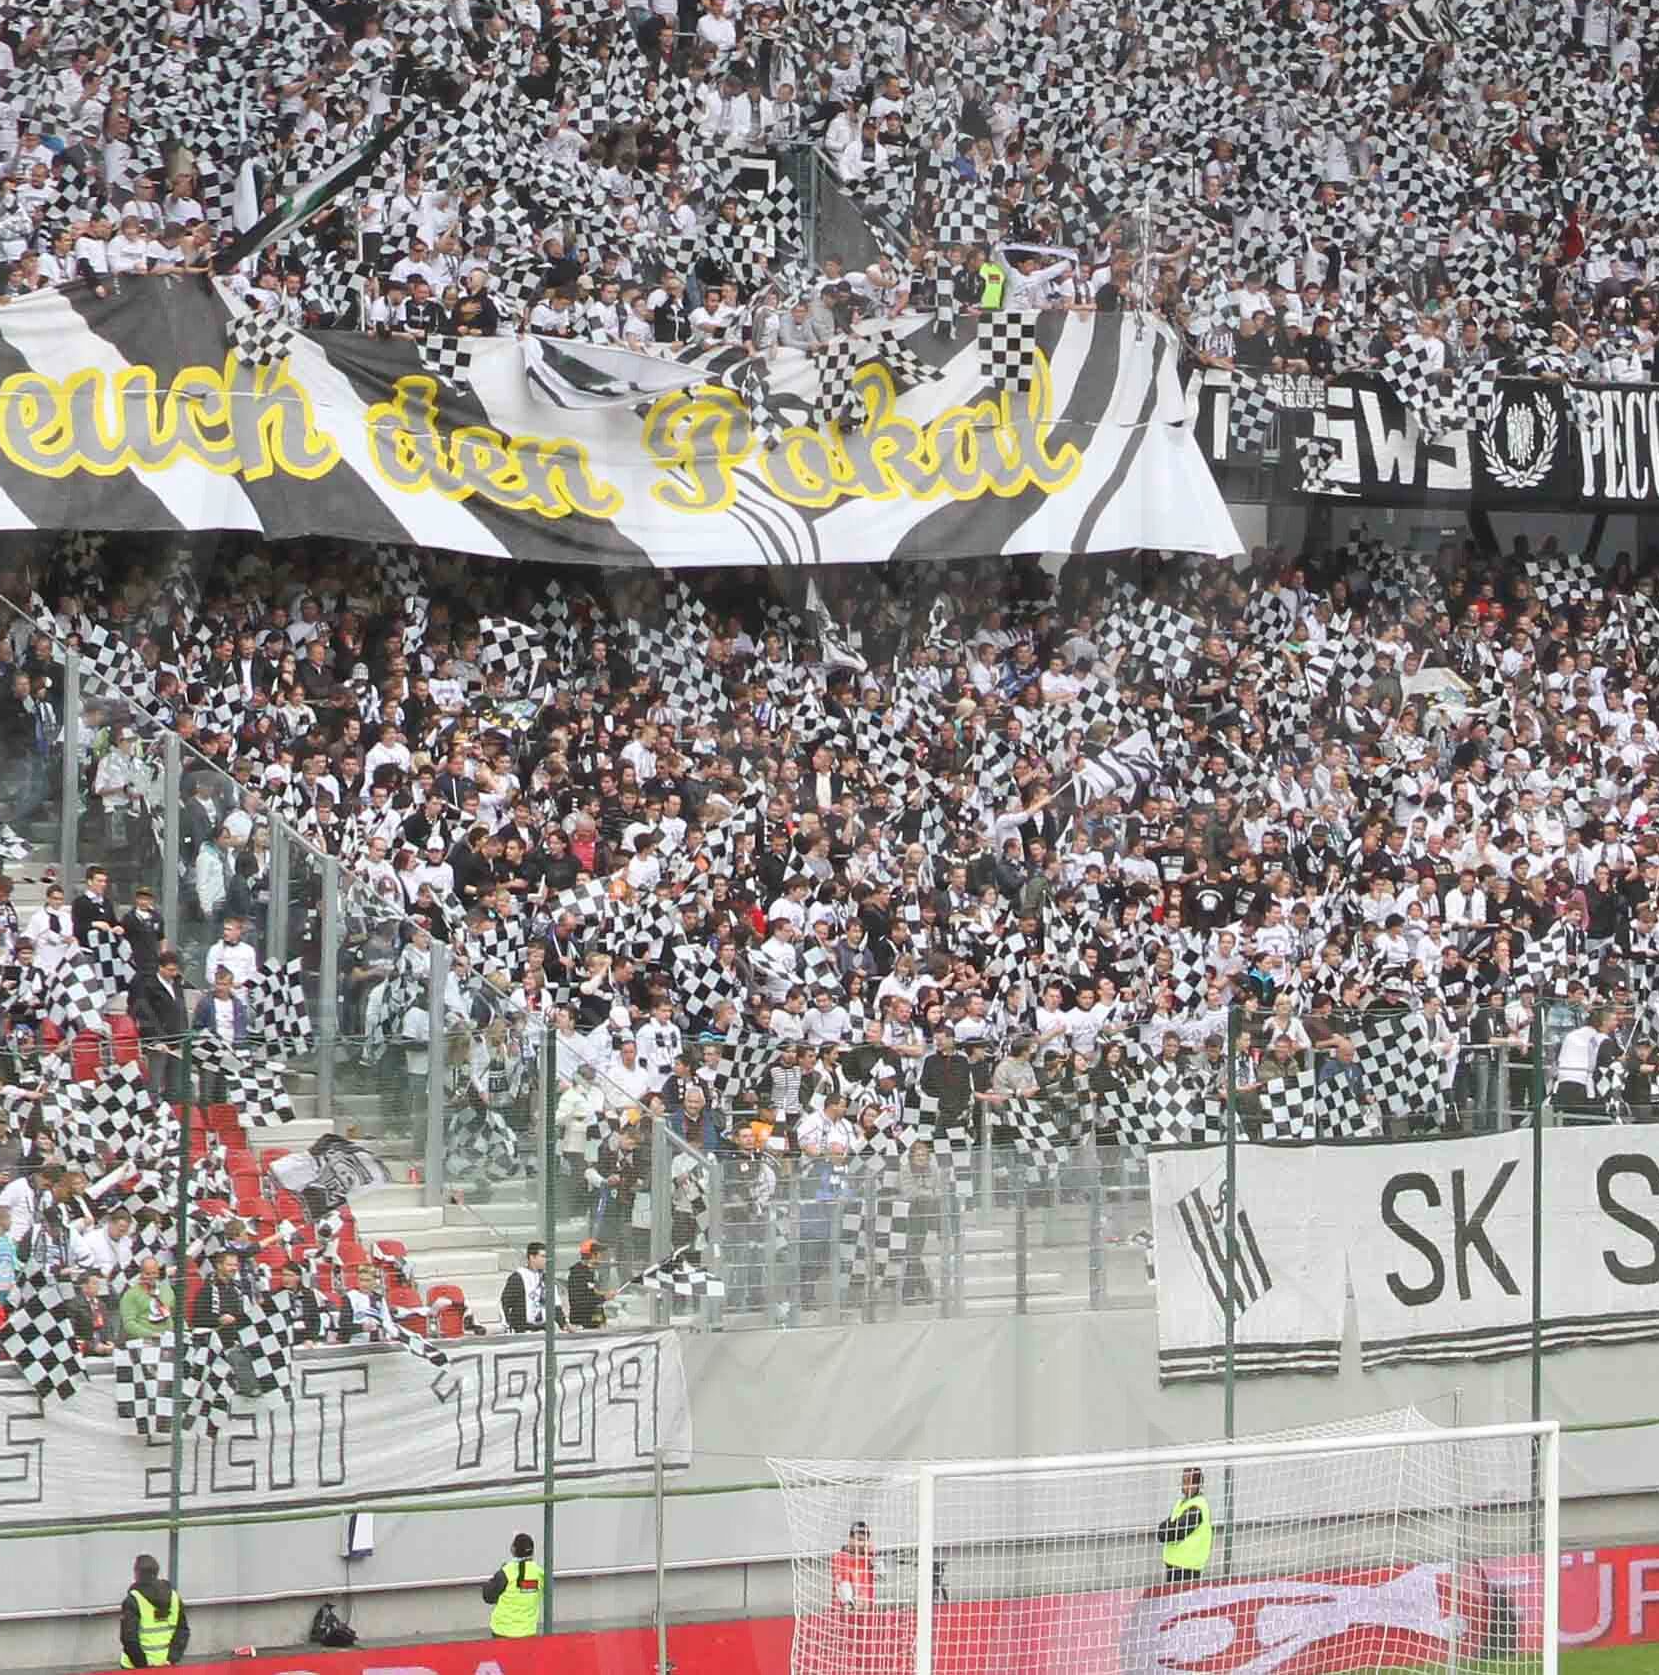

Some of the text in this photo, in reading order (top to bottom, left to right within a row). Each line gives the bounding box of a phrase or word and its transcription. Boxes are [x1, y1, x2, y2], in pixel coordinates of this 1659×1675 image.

[366, 373, 624, 519] den
[643, 347, 1084, 514] Pokal
[1383, 1158, 1519, 1310] SK
[432, 1340, 661, 1472] 1909
